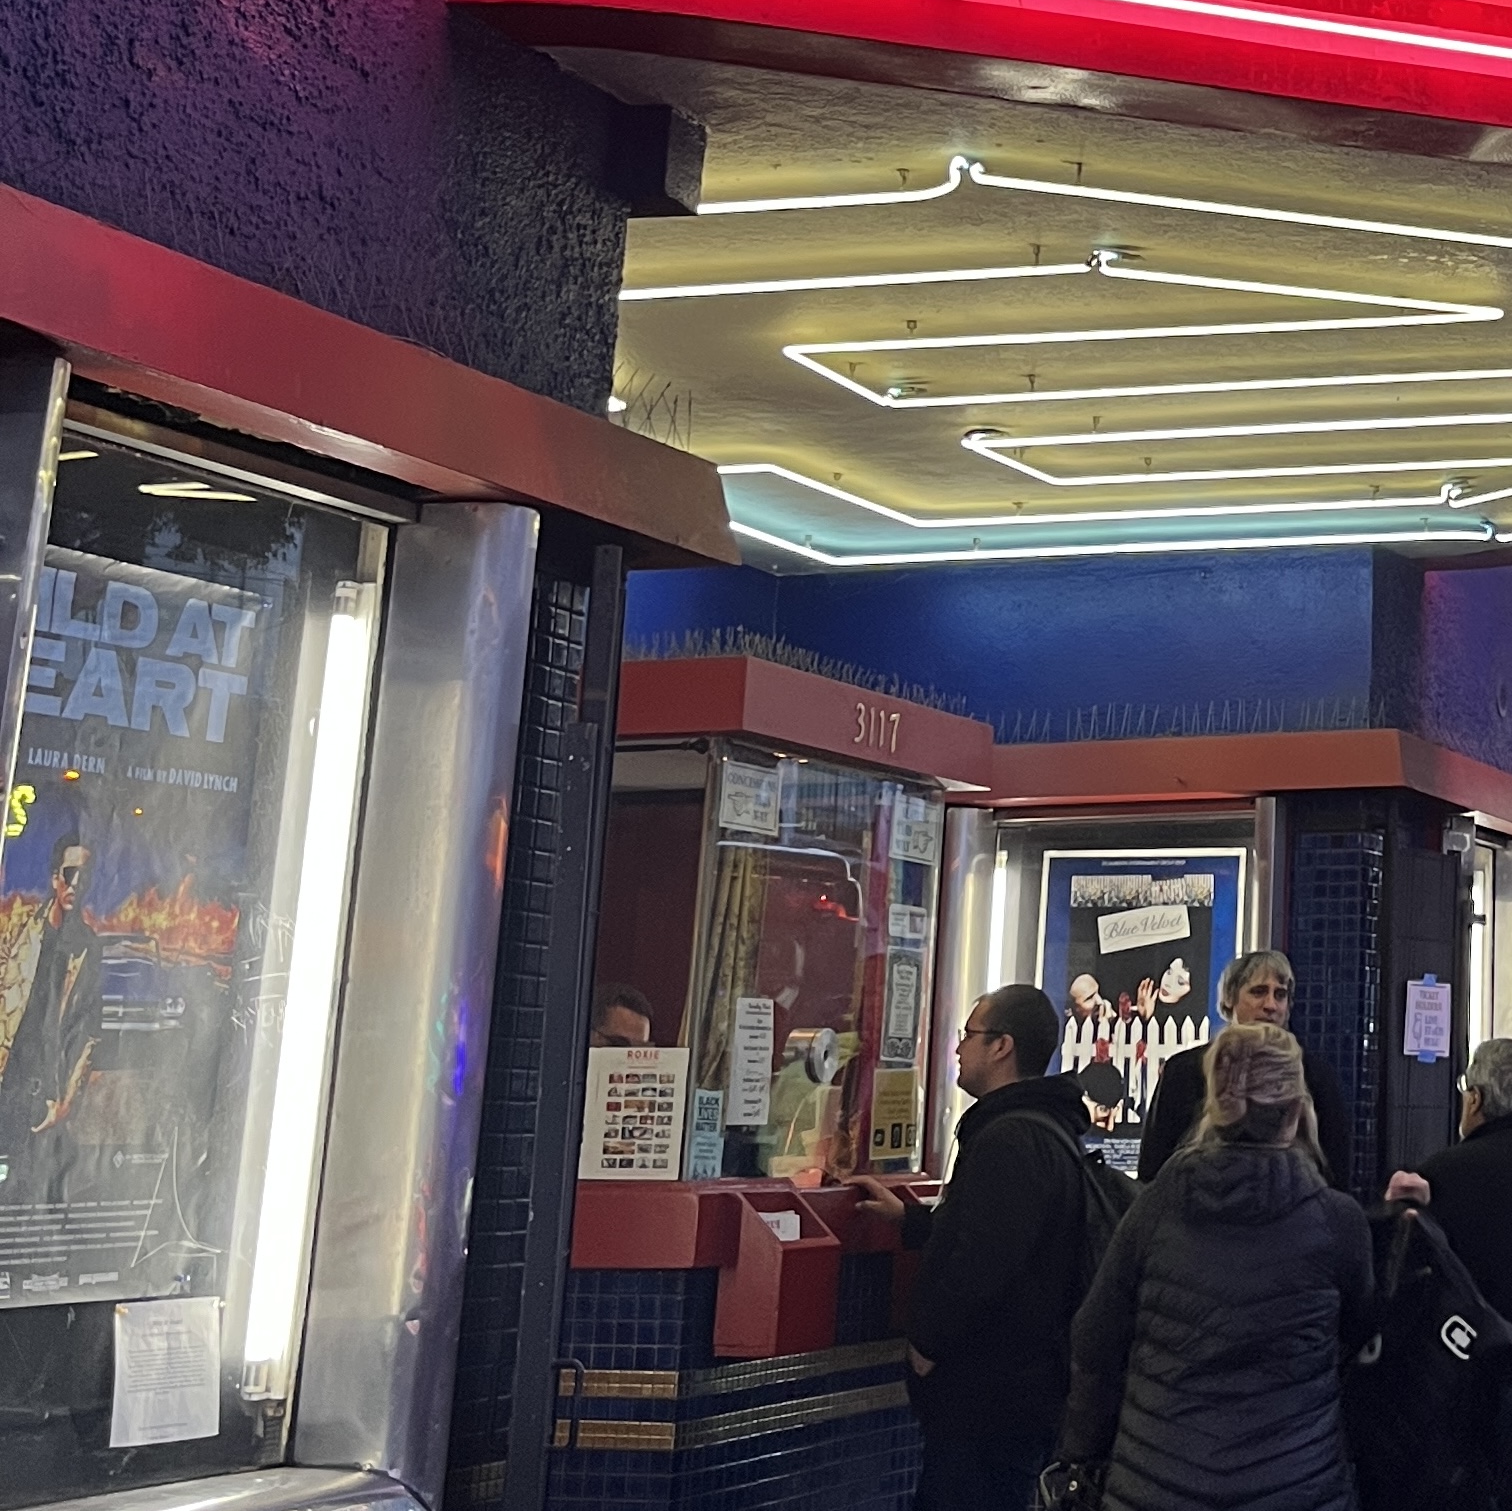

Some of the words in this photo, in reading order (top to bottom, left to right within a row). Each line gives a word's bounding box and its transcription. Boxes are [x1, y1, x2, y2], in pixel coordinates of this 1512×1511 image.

[35, 566, 158, 648] ILD
[165, 598, 256, 668] AT
[24, 636, 249, 743] EART
[854, 702, 900, 753] 3117
[28, 747, 68, 769] LAURA
[72, 754, 105, 775] DERN
[168, 767, 200, 788] DAVID
[203, 773, 238, 793] LYNCH
[1103, 920, 1139, 941] Blue
[1141, 912, 1182, 933] Velvet
[627, 1050, 660, 1061] ROXIE
[697, 1108, 719, 1120] LIVES
[698, 1096, 720, 1107] BLACK
